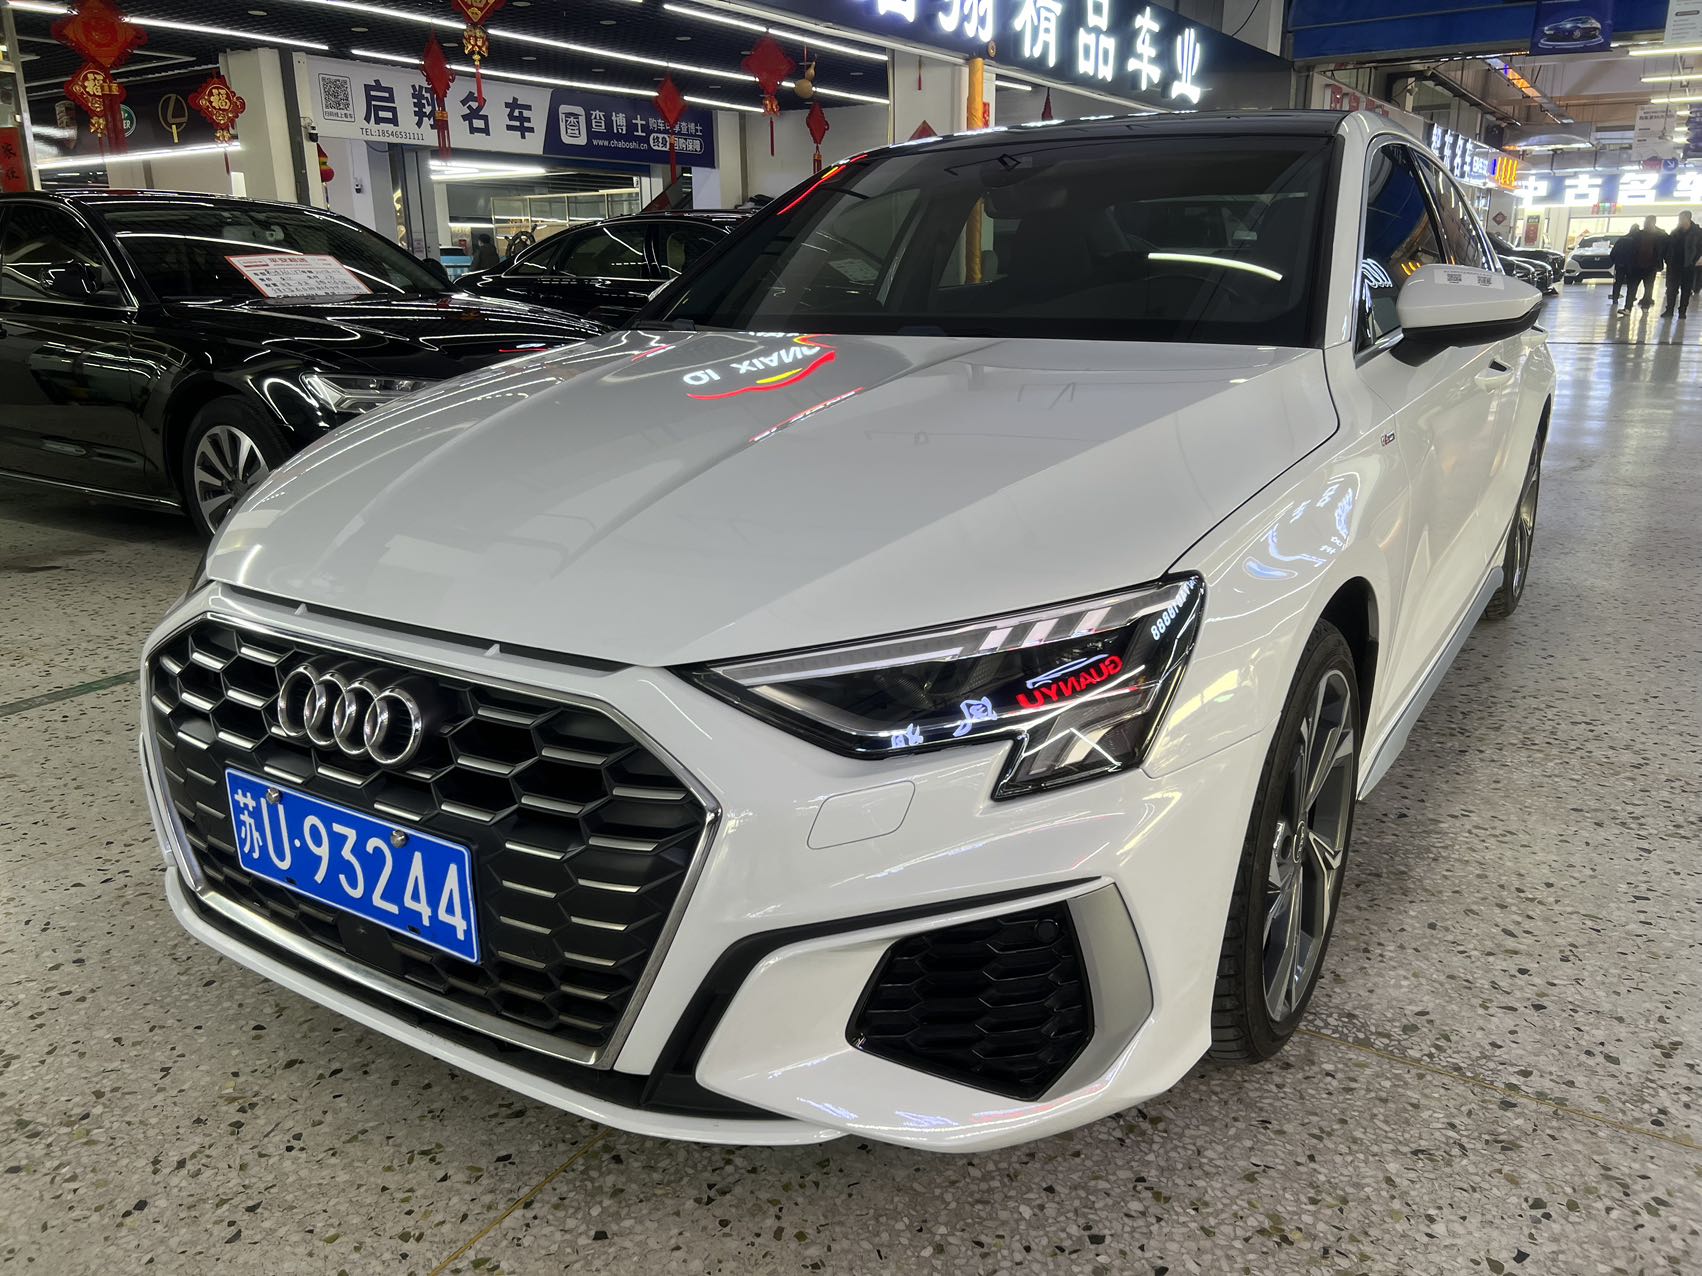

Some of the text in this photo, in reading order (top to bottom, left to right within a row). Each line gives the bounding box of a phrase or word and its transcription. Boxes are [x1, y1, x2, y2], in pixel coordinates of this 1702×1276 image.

[877, 0, 1202, 104] 精品车业
[363, 78, 535, 140] 启翔名车
[590, 110, 646, 137] 查博士
[592, 138, 648, 150] www.chaboshi.cn
